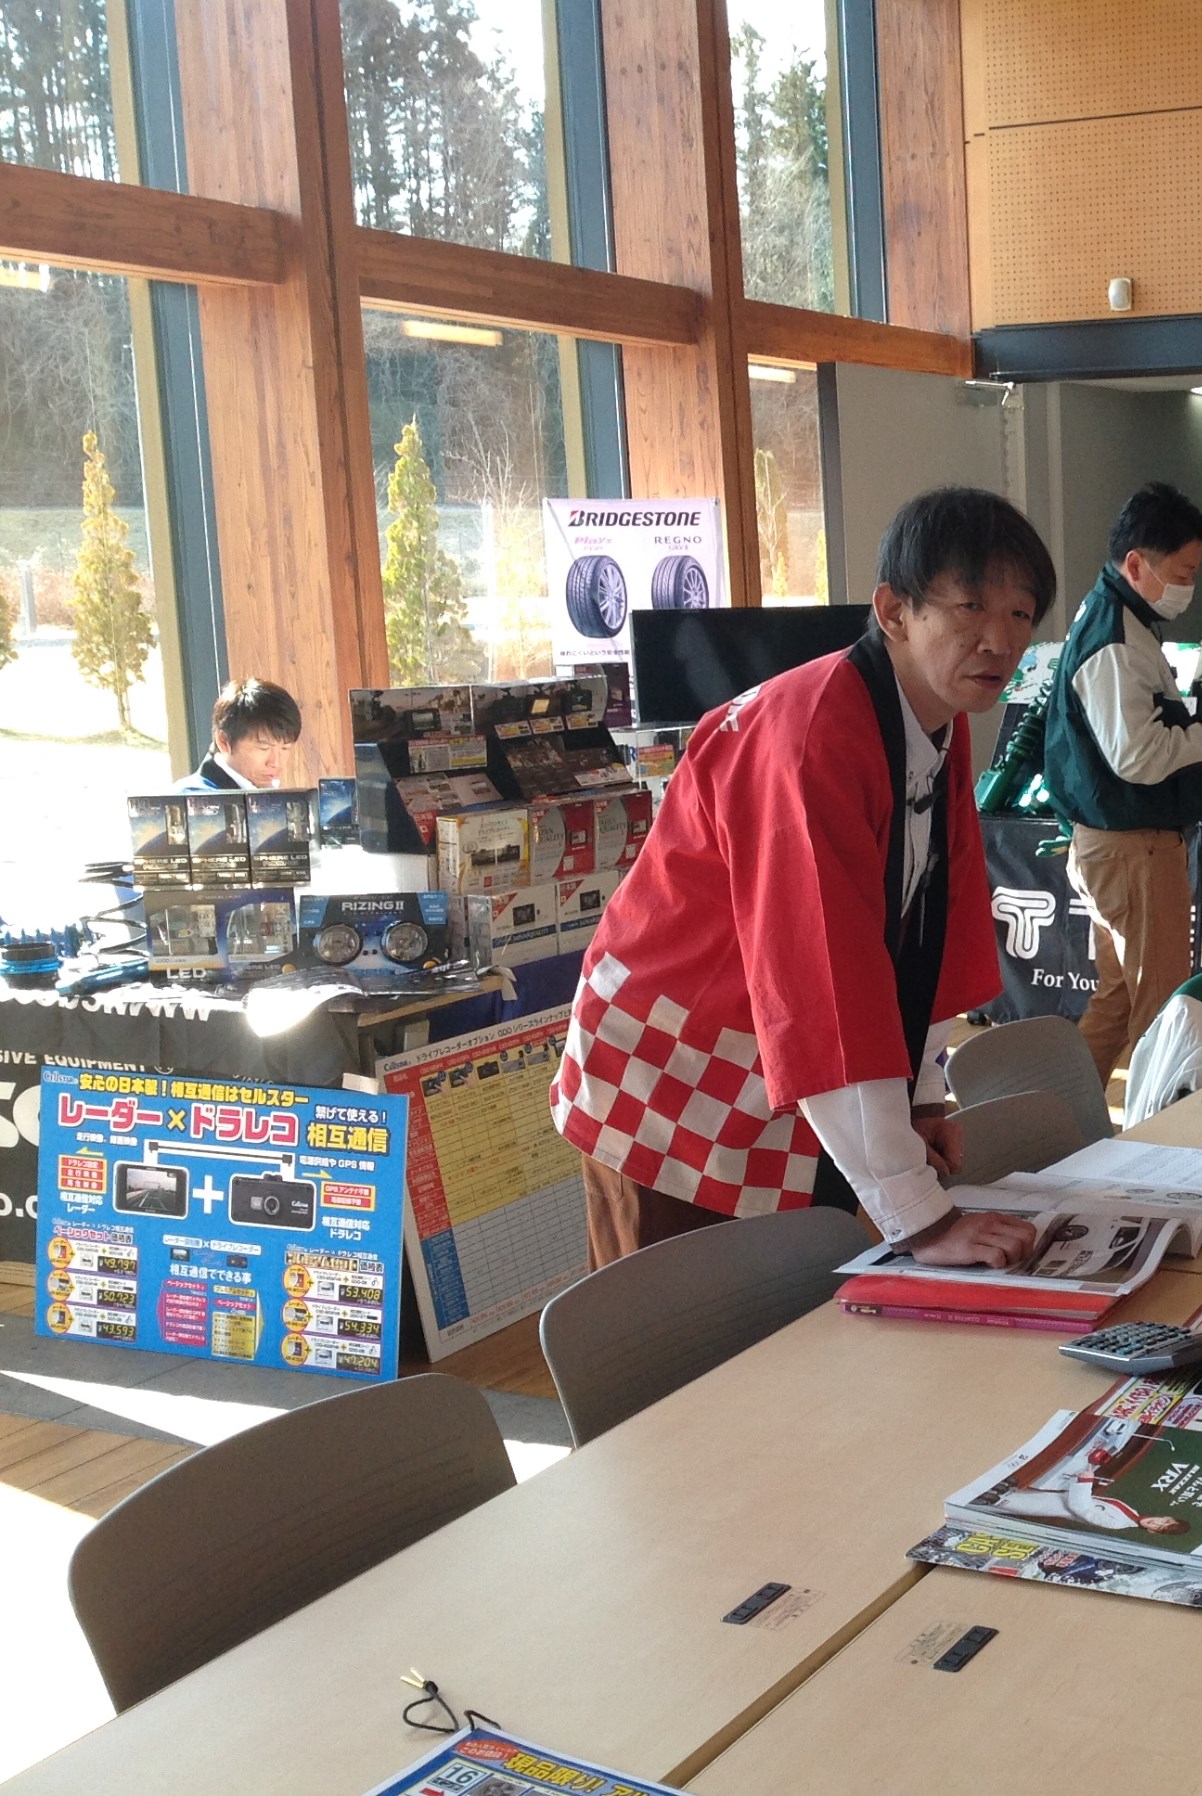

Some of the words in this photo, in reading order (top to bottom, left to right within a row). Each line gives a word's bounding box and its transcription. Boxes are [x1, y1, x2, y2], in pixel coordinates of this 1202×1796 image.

[568, 510, 702, 527] BRIDGESTONE
[654, 536, 702, 544] REGNO
[342, 901, 395, 911] RIZING
[166, 968, 208, 979] LED
[1031, 968, 1064, 988] For
[308, 1122, 389, 1154] 相互通信
[338, 1160, 357, 1169] GPS
[67, 1203, 96, 1214] レーダー
[329, 1229, 362, 1241] ドラレコ
[1150, 1462, 1190, 1492] VRX
[1168, 1464, 1201, 1495] BLIZZAK
[445, 1766, 479, 1784] 16
